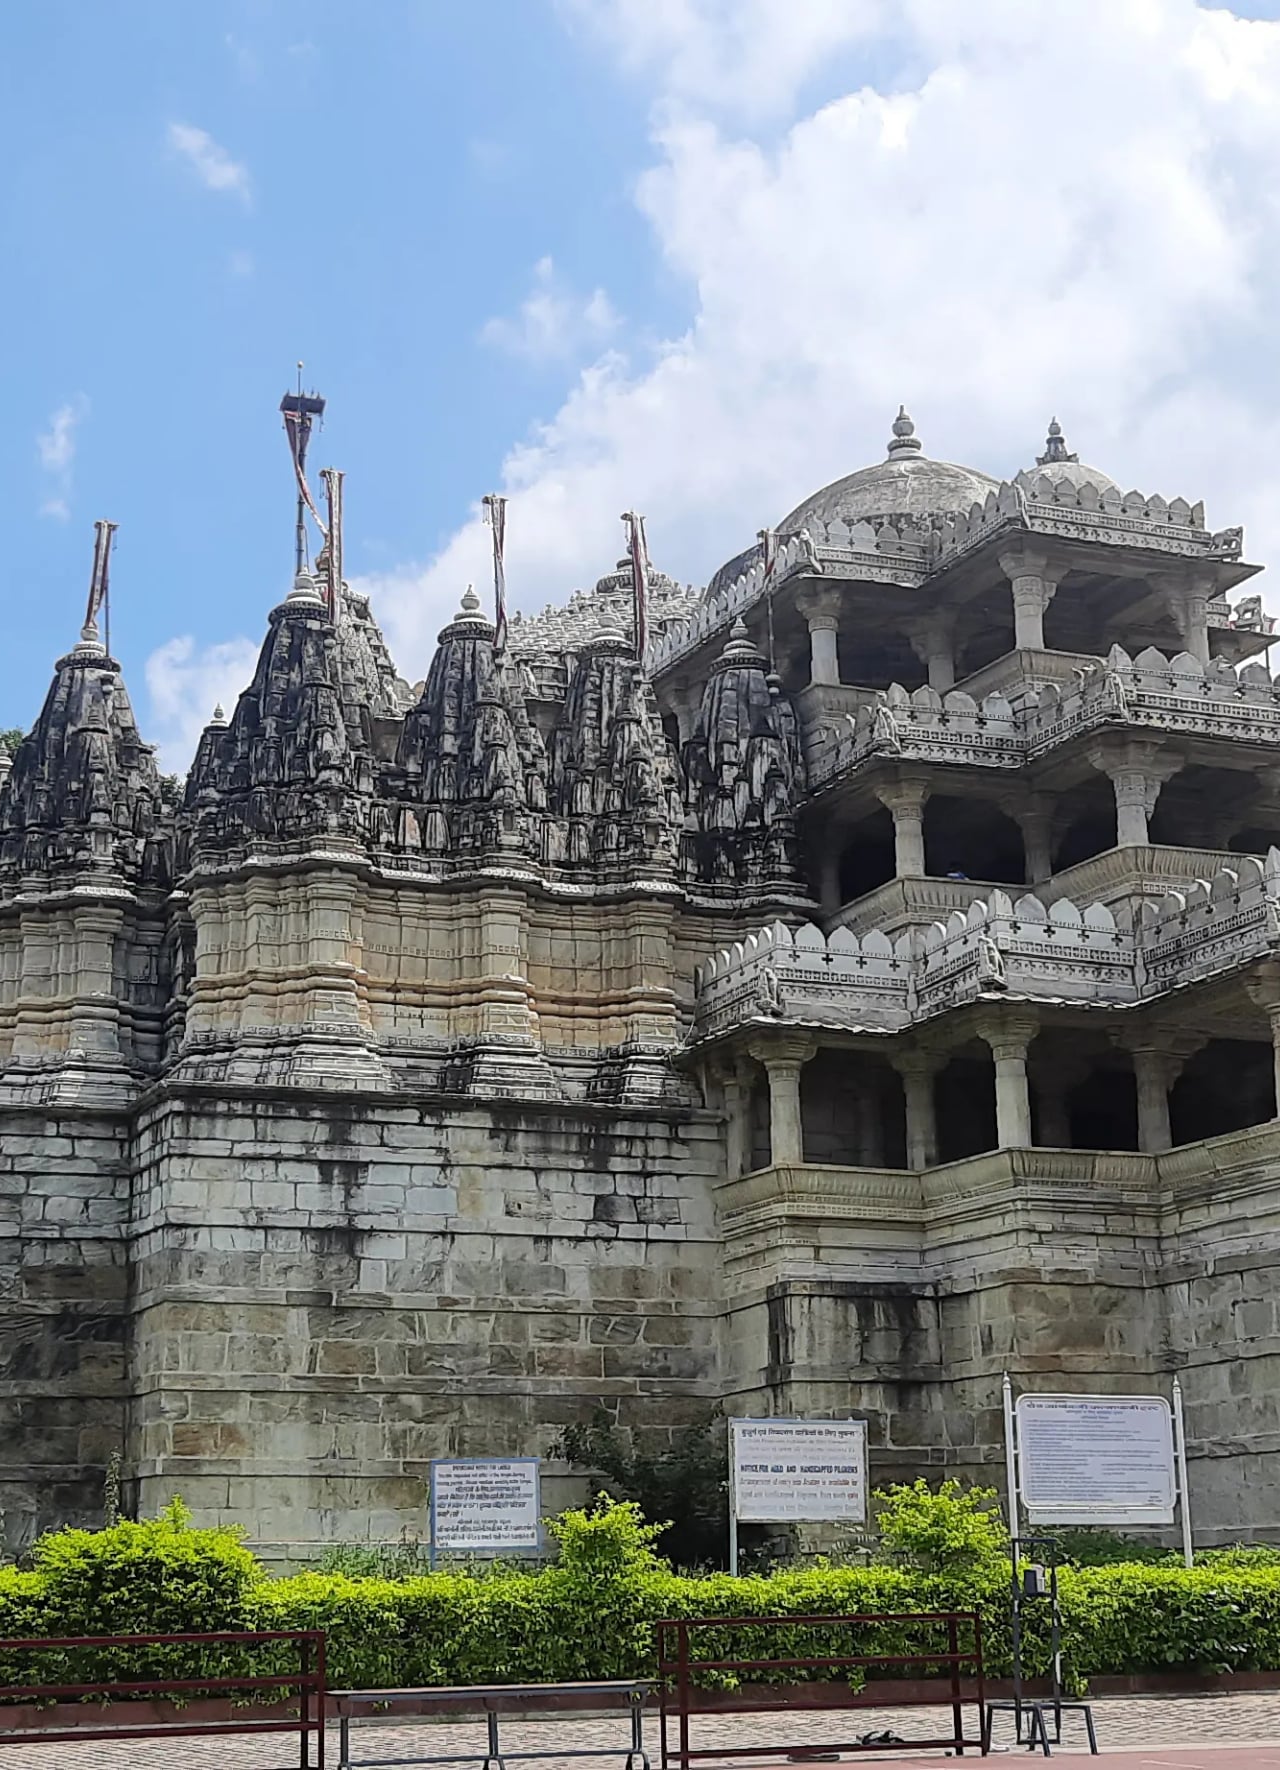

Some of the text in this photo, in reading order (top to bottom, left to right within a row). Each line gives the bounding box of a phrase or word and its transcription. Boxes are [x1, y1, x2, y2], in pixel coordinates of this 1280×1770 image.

[740, 1464, 758, 1473] NOTICE
[758, 1464, 769, 1473] FOR
[786, 1464, 797, 1473] AND
